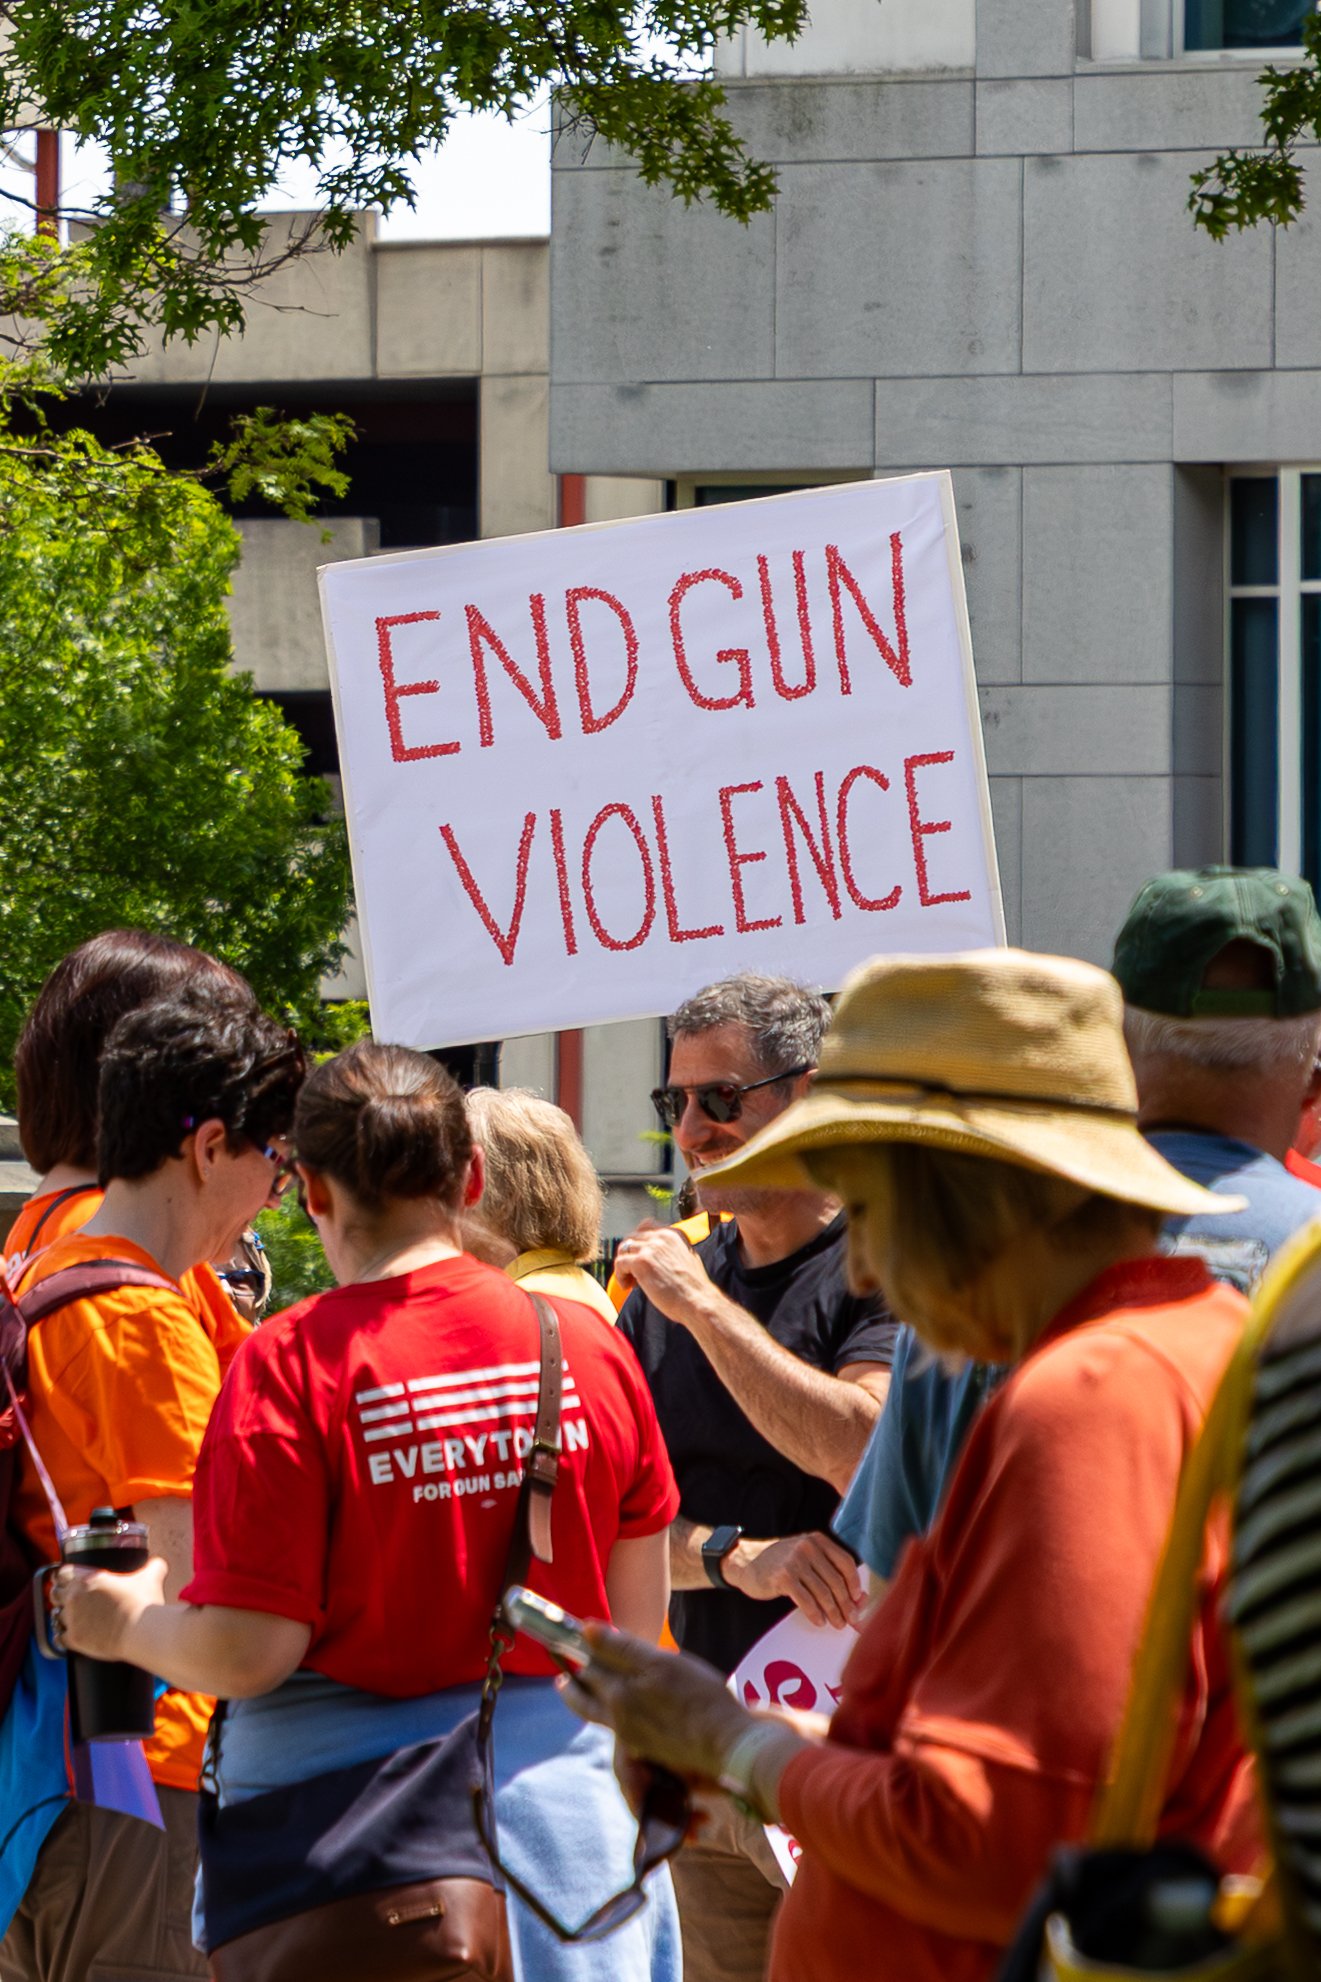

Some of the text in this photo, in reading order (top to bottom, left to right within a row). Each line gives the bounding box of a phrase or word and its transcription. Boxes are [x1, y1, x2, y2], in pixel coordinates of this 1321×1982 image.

[376, 533, 913, 762] END GUN
[440, 751, 971, 965] VIOLENCE
[413, 1482, 452, 1503] FOR
[452, 1474, 491, 1497] GUN
